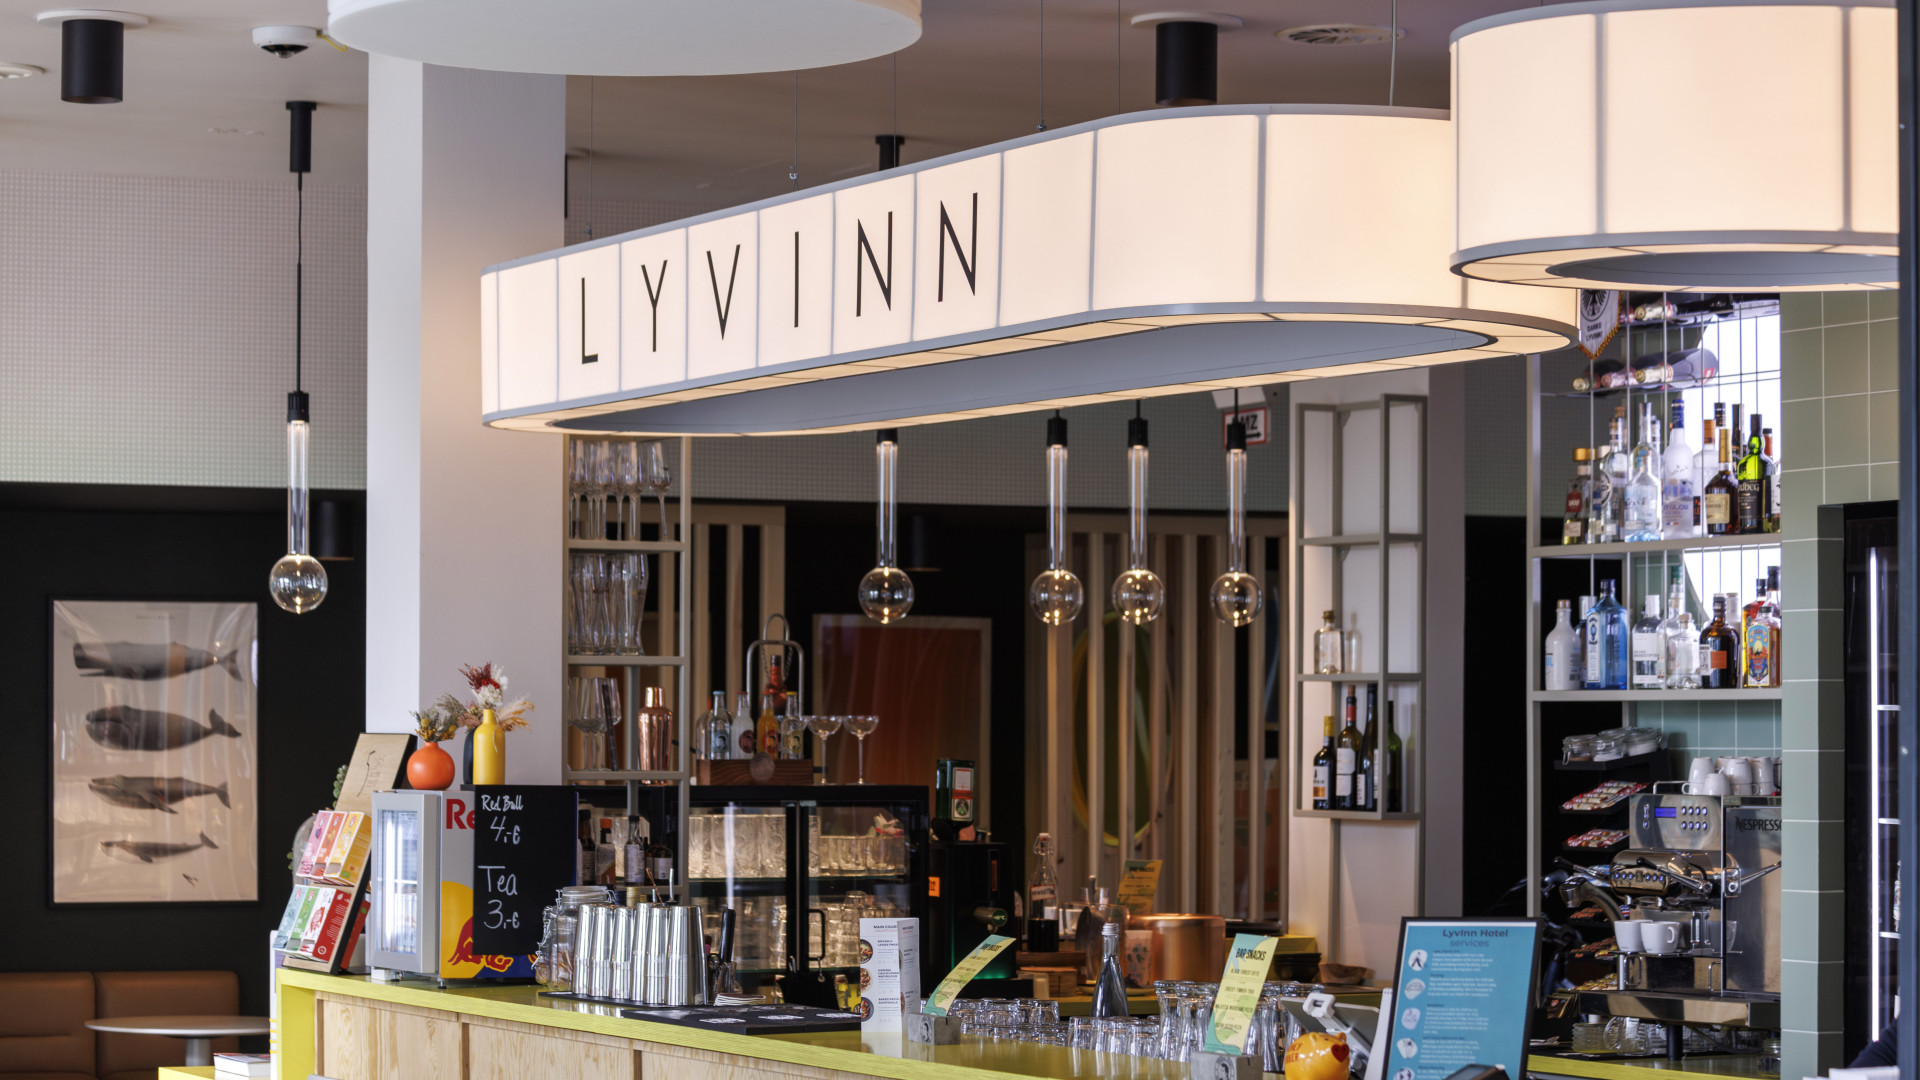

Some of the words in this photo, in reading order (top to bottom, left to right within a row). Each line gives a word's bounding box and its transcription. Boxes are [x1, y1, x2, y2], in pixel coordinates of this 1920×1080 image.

[581, 192, 978, 364] LYVINN
[481, 794, 502, 812] Red
[502, 794, 524, 812] Bull
[1734, 815, 1782, 833] NESPRESS
[477, 865, 518, 896] Tea
[1442, 928, 1477, 938] LyvInn
[1480, 929, 1509, 938] Hotel
[1449, 939, 1490, 948] services
[1235, 947, 1247, 959] BAR
[1245, 949, 1267, 961] SNACKS
